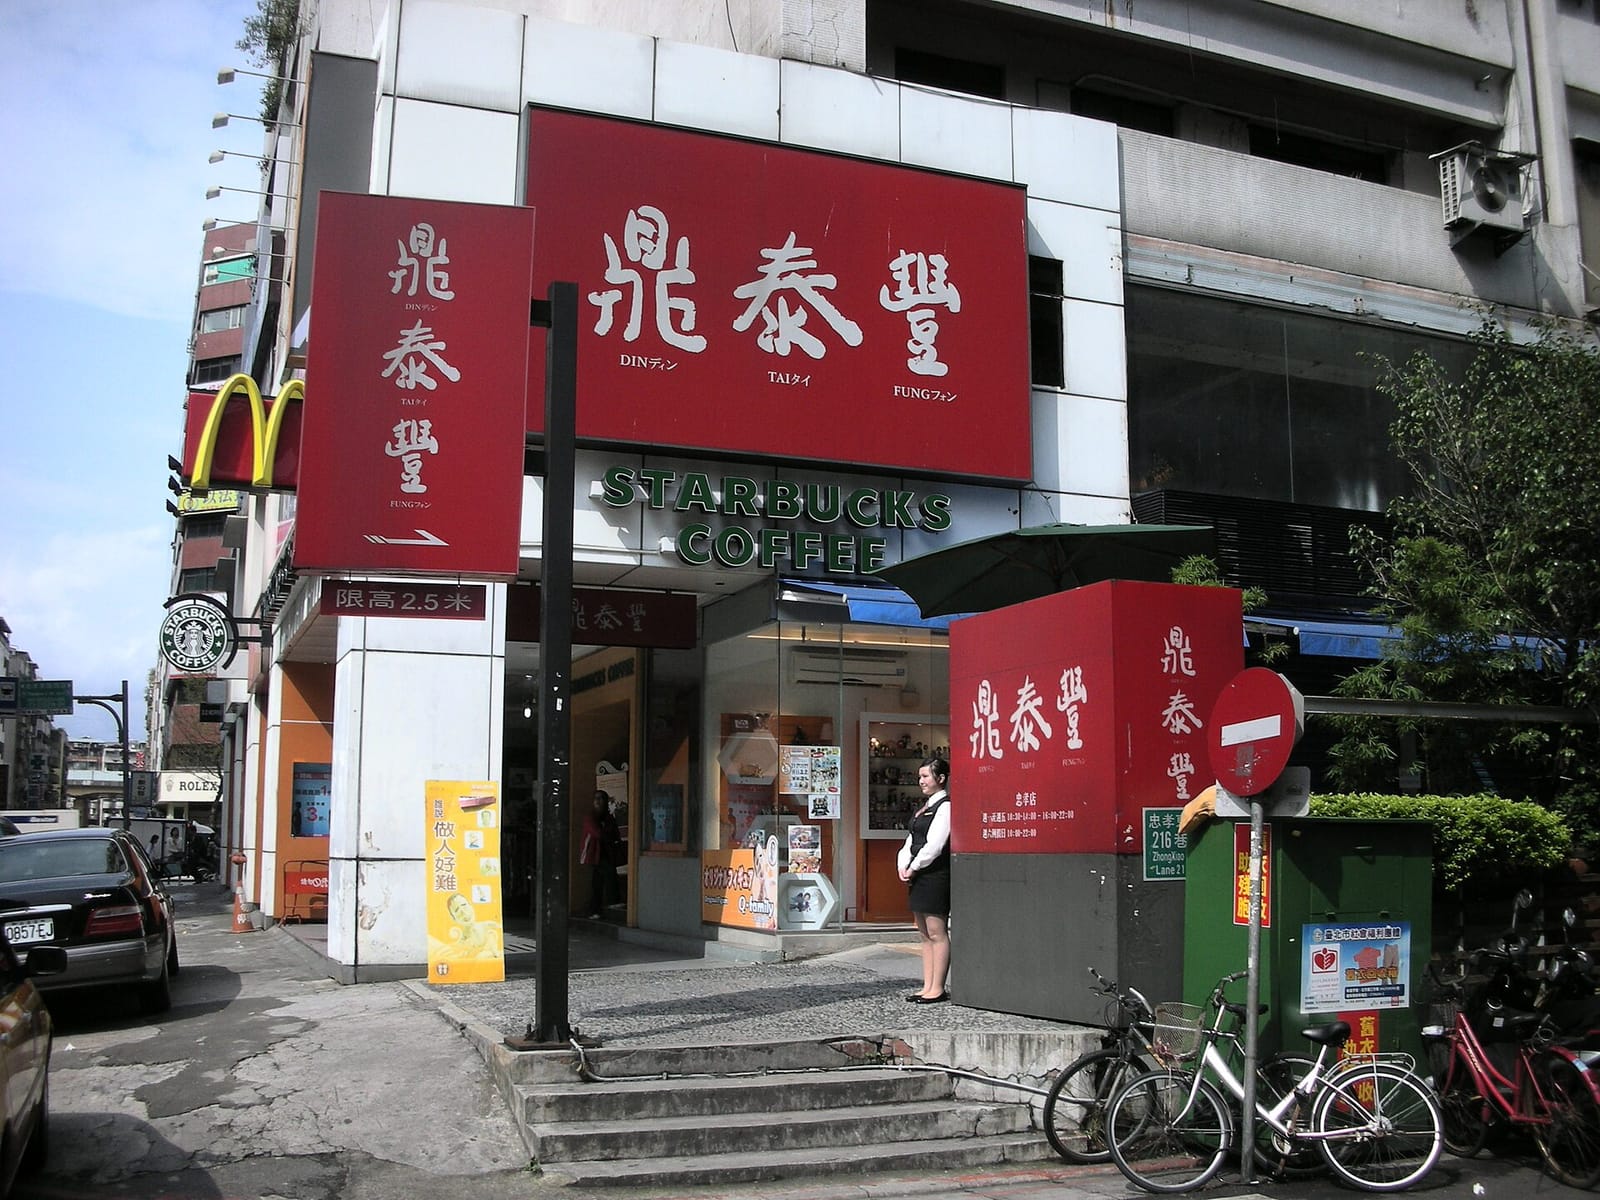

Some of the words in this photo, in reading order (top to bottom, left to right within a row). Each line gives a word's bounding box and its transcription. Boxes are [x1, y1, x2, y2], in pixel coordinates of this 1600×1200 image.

[588, 204, 962, 378] 鼎泰豐
[381, 222, 461, 493] 鼎泰豐
[619, 353, 679, 371] DINディン
[767, 370, 811, 387] TAIタイ
[893, 385, 957, 403] FUNGフォン
[601, 467, 953, 532] STARBUCKS
[677, 522, 889, 575] COFFEE
[335, 588, 472, 612] 限高2.5米
[164, 608, 224, 637] STARBUCKS
[170, 650, 216, 667] COFFEE
[969, 665, 1087, 760] 鼎泰豐
[1160, 625, 1203, 800] 鼎泰豐
[179, 781, 218, 791] ROLEX
[434, 821, 456, 891] 做人好難
[1156, 864, 1175, 875] Lane
[1358, 1016, 1376, 1102] 舊衣收
